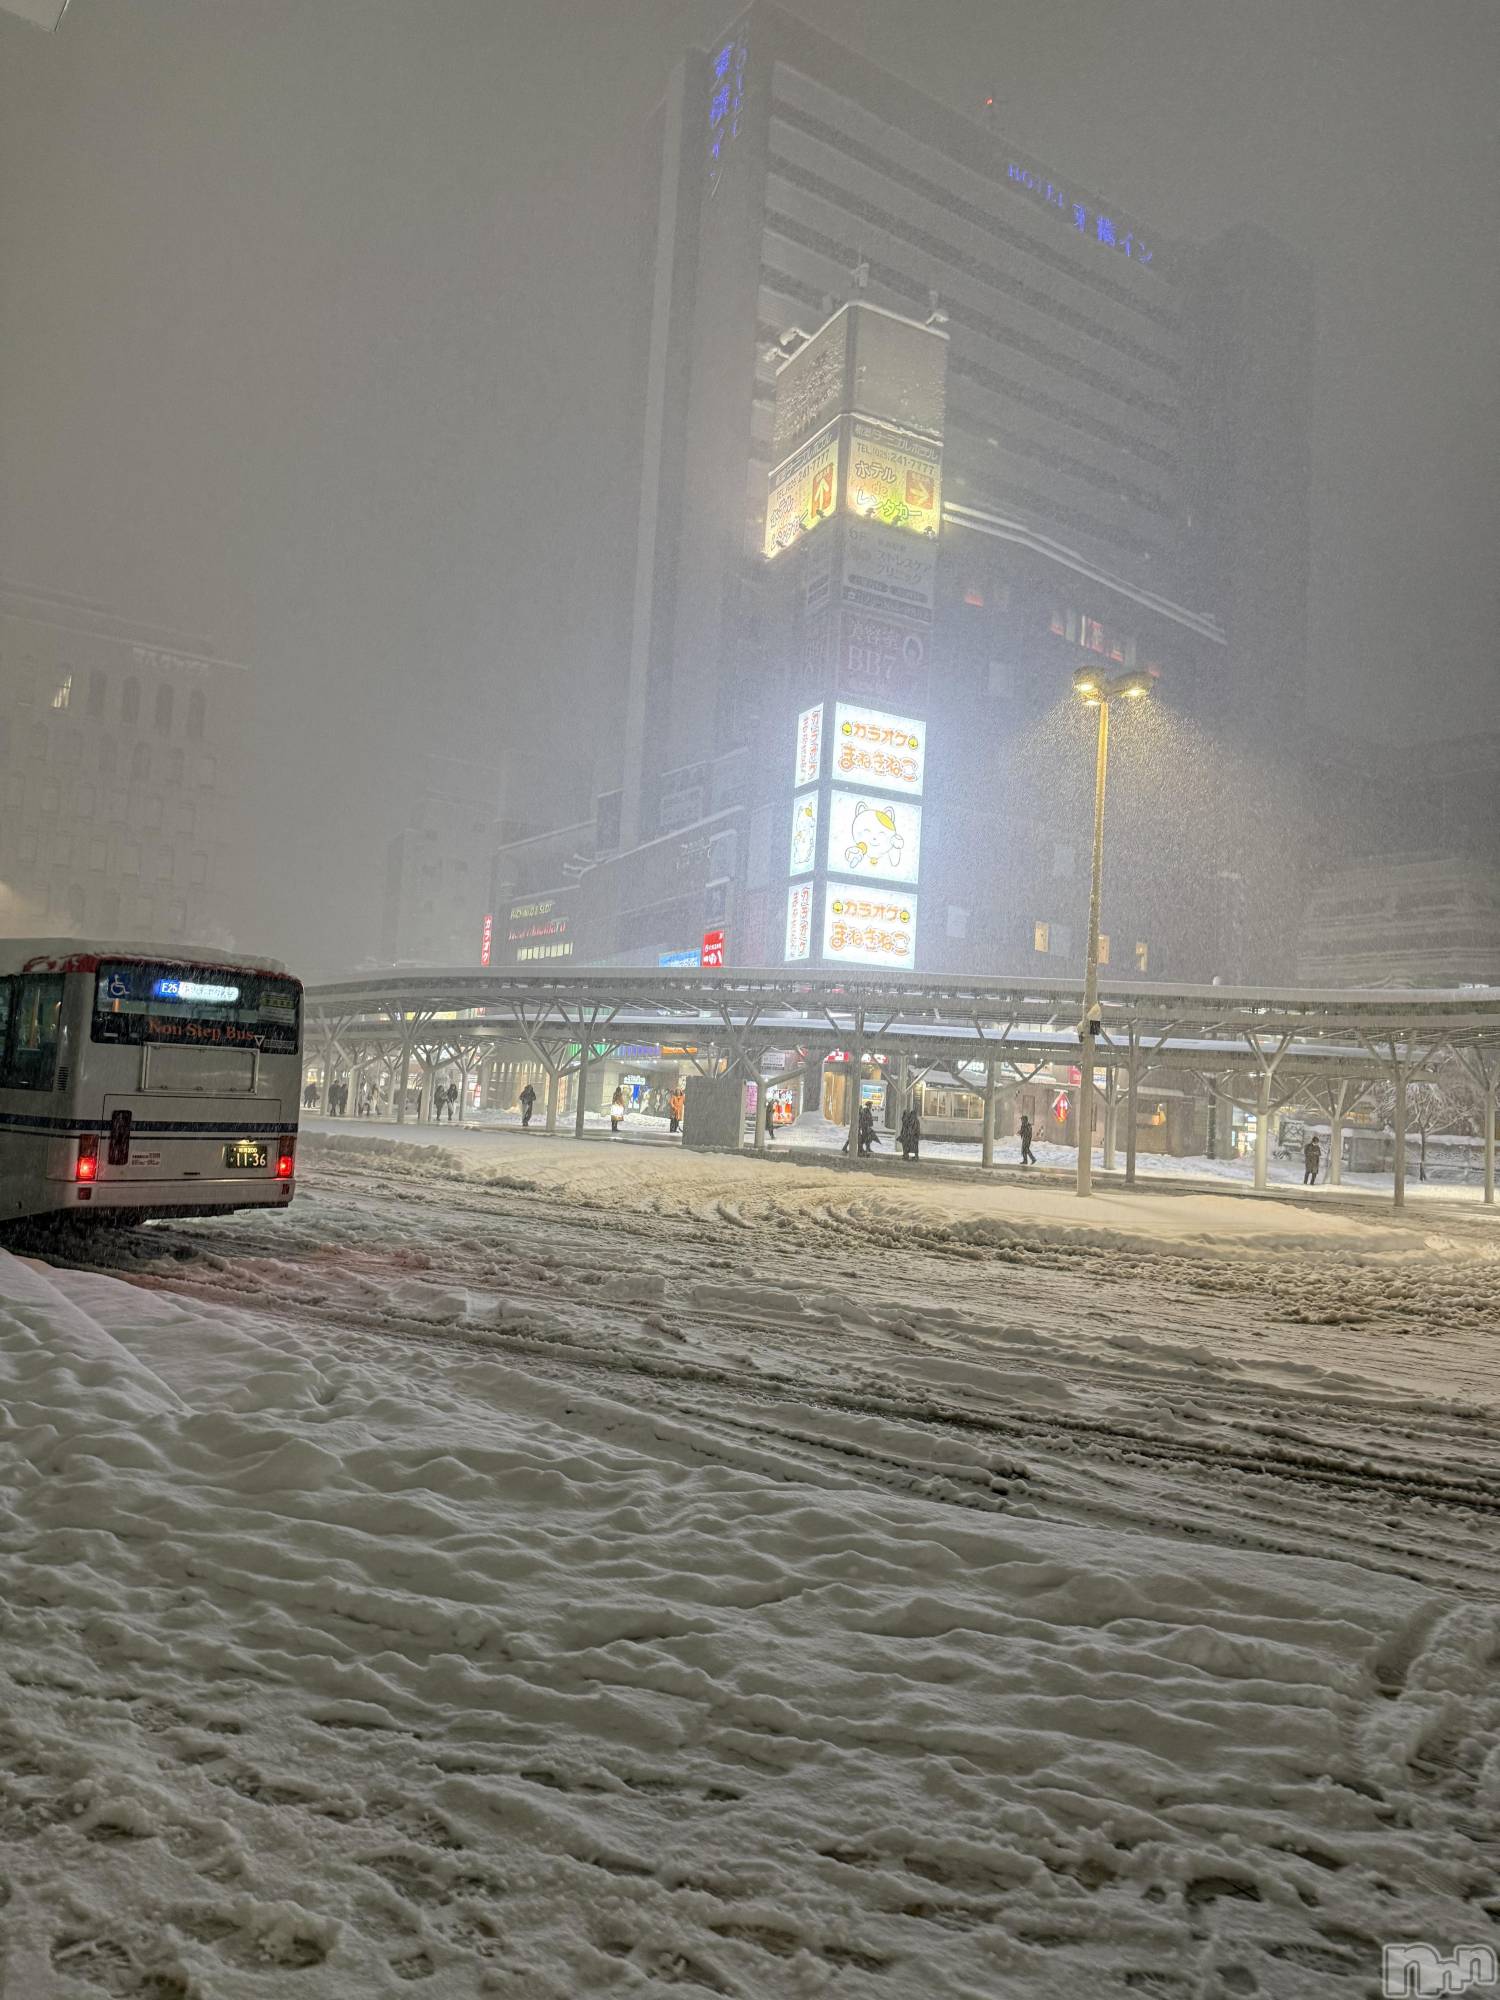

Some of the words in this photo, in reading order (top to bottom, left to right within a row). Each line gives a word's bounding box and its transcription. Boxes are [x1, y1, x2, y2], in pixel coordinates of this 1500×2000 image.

[854, 459, 897, 485] ホテル
[856, 488, 923, 519] レンタカー
[847, 645, 897, 680] BB7
[852, 722, 909, 748] カラオケ
[838, 743, 918, 782] まねきねこ
[843, 900, 899, 923] カラオケ
[482, 917, 491, 962] カラオケ
[829, 922, 911, 956] まねきねこ
[160, 981, 178, 994] E25
[186, 1022, 221, 1041] Step
[226, 1025, 255, 1042] Bus
